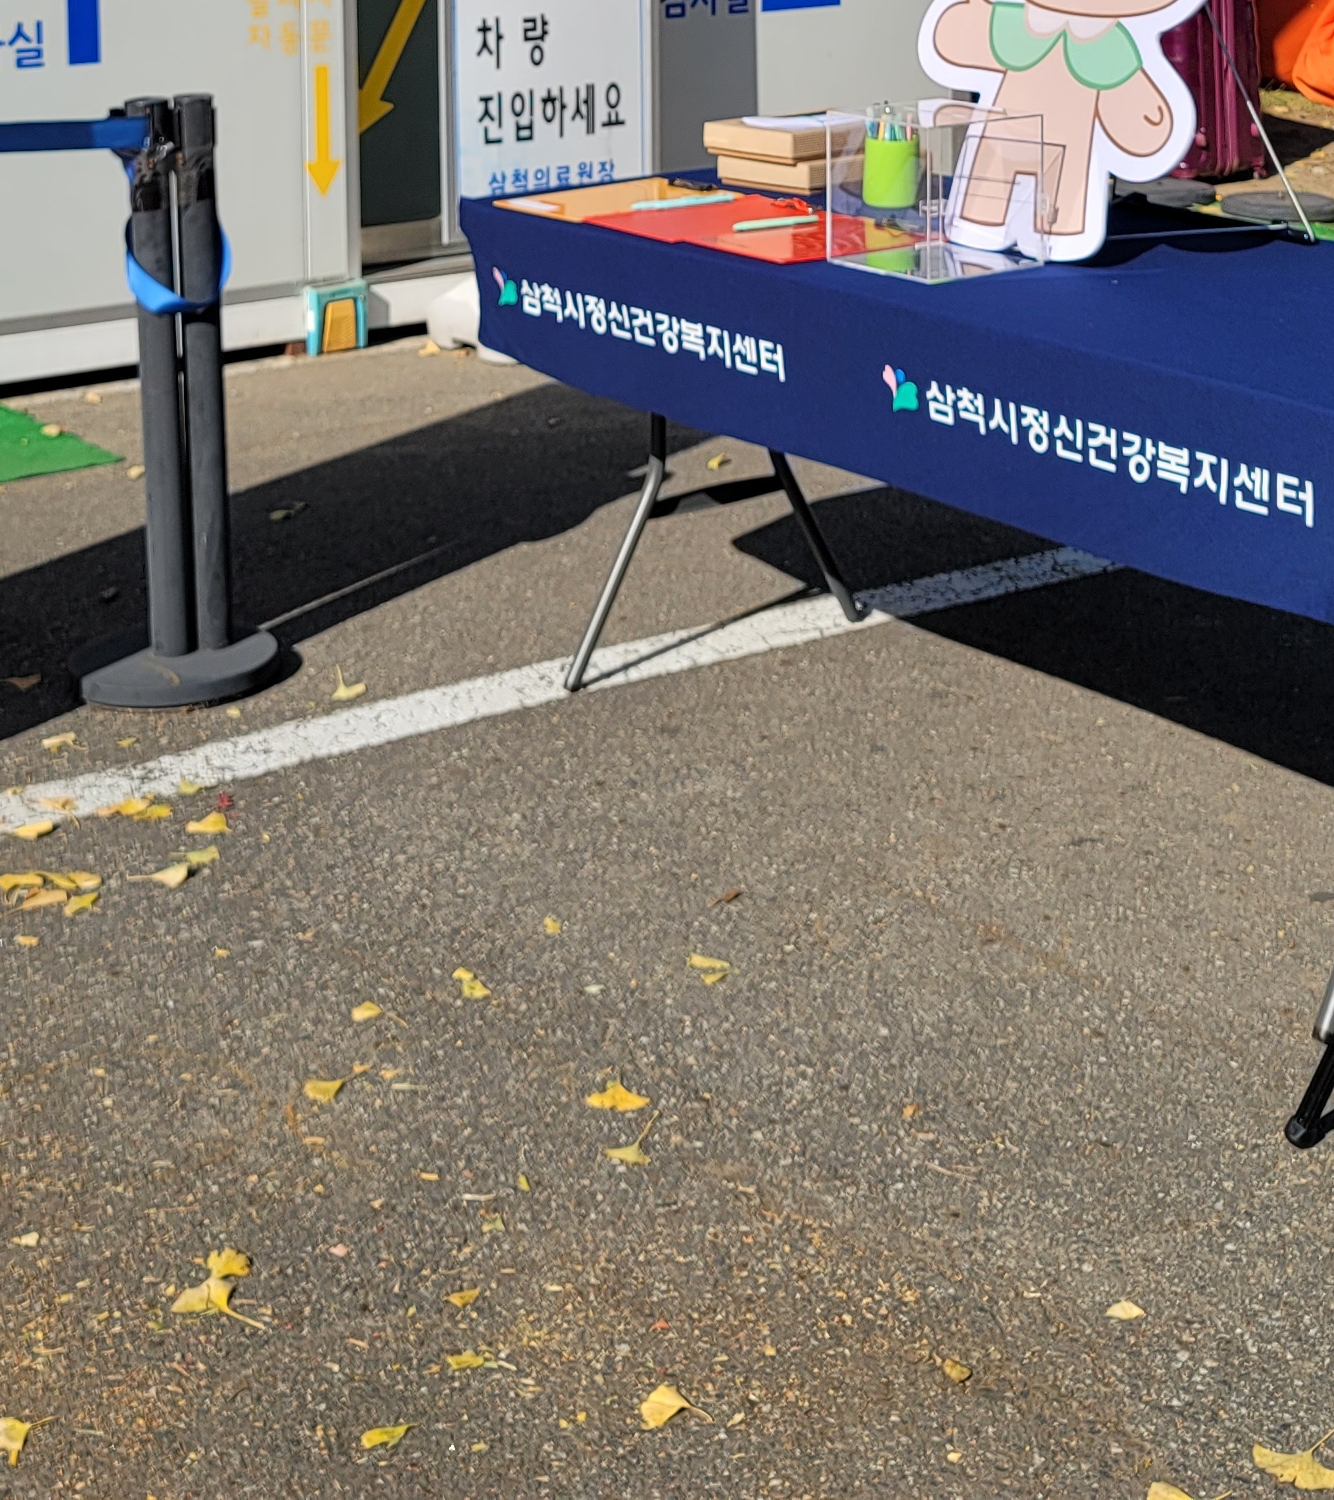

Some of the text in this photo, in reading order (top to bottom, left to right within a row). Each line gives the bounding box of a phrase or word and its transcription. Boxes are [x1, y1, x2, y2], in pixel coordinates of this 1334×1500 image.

[476, 13, 550, 70] 차량
[477, 82, 627, 146] 진입하세요
[520, 278, 787, 383] 삼척시정신건강복지센터
[925, 379, 1315, 529] 삼척시정신건강복지센터
